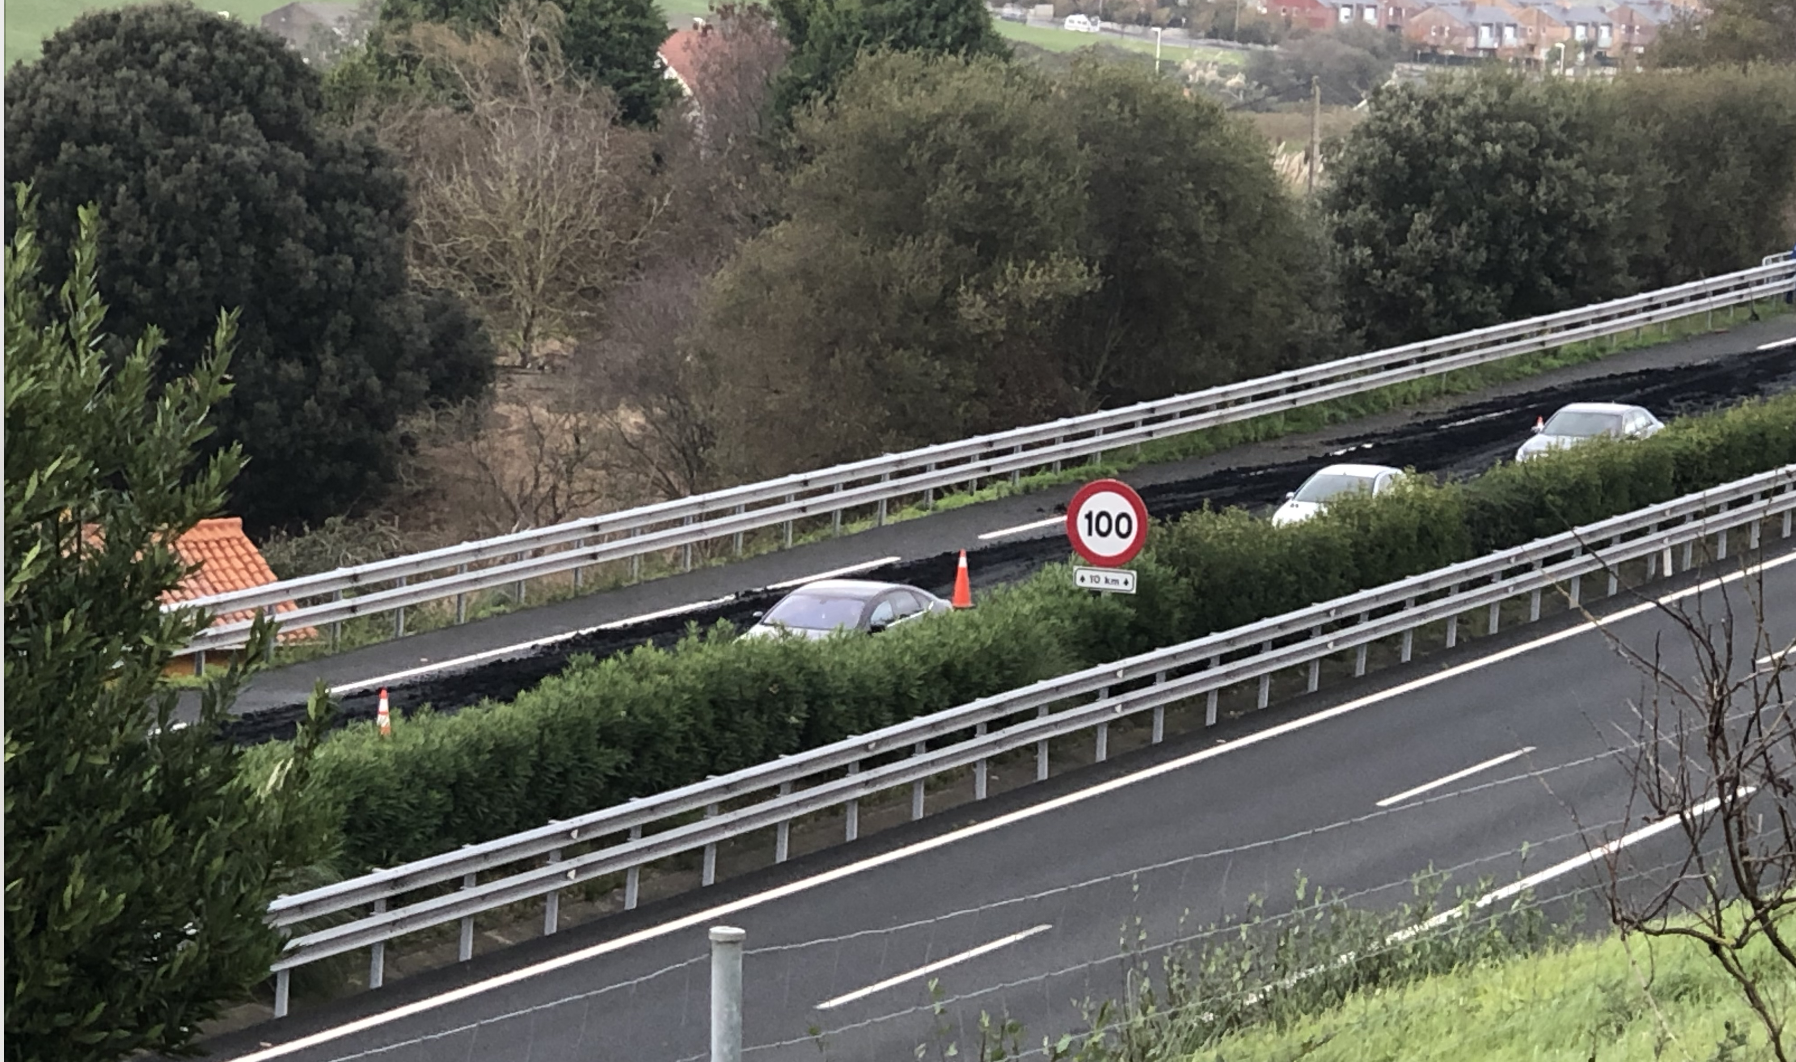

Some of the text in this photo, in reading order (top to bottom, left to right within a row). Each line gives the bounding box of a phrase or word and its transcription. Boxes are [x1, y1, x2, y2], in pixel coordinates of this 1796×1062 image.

[1084, 510, 1133, 539] 100
[1090, 574, 1119, 586] 10 km
